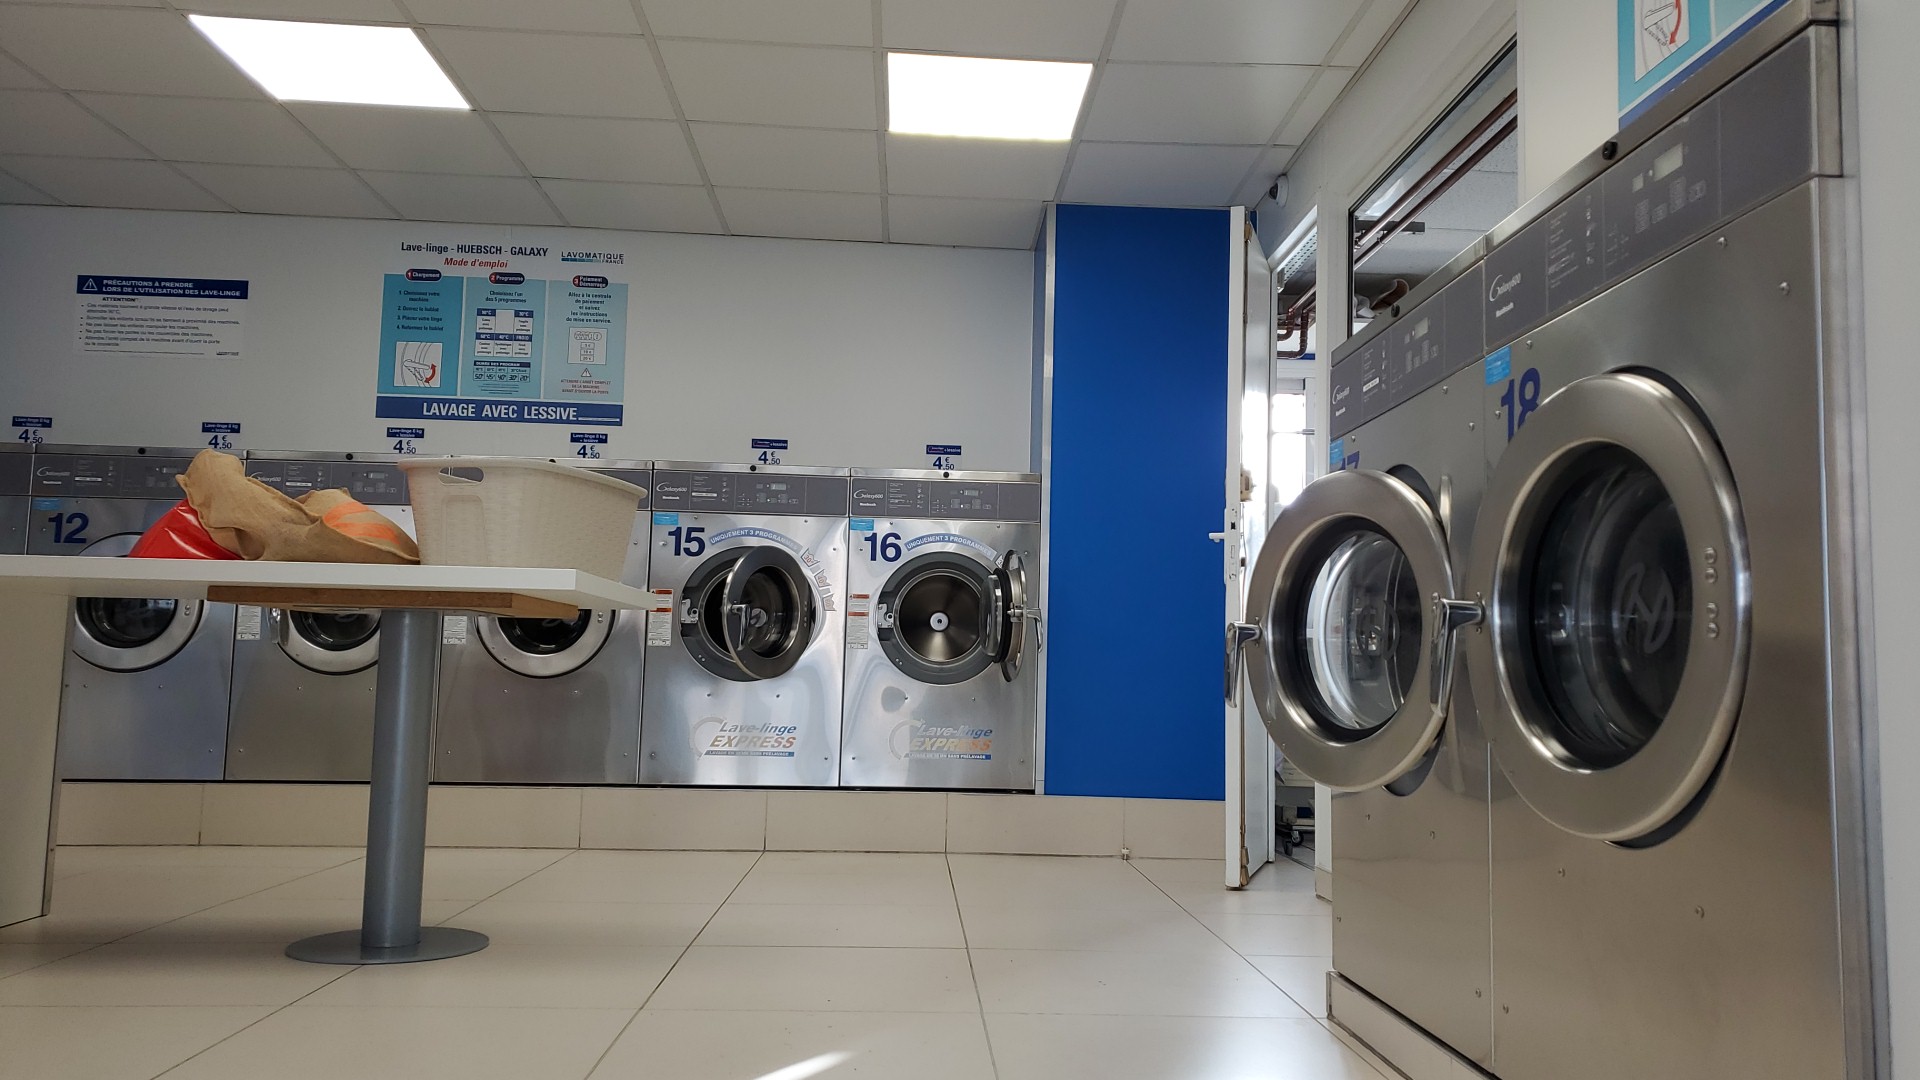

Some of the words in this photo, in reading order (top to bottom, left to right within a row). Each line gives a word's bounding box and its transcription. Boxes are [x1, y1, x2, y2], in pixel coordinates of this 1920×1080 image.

[401, 242, 449, 254] Lave-linge
[456, 245, 502, 255] HUEBSCH
[510, 246, 549, 257] GALAXY
[561, 251, 624, 261] LAVOMATIQUE
[443, 257, 468, 267] Mode
[470, 258, 509, 270] d'emploi
[422, 402, 476, 417] LAVAGE
[481, 404, 518, 418] AVEC
[524, 406, 578, 420] LESSIVE
[1500, 367, 1541, 441] 18
[18, 428, 30, 443] 4
[208, 434, 220, 449] 4
[392, 440, 404, 454] 4
[576, 444, 588, 458] 4
[758, 450, 769, 464] 4
[932, 456, 943, 470] 4
[48, 512, 89, 544] 12
[668, 526, 706, 557] 15
[710, 529, 748, 545] UNIQUEMENT
[906, 535, 944, 550] UNIQUEMENT
[864, 532, 902, 562] 16
[719, 721, 797, 736] Lave-linge
[918, 724, 993, 740] Lave-linge
[709, 735, 797, 749] EXPRESS
[910, 737, 992, 752] EXPRESS
